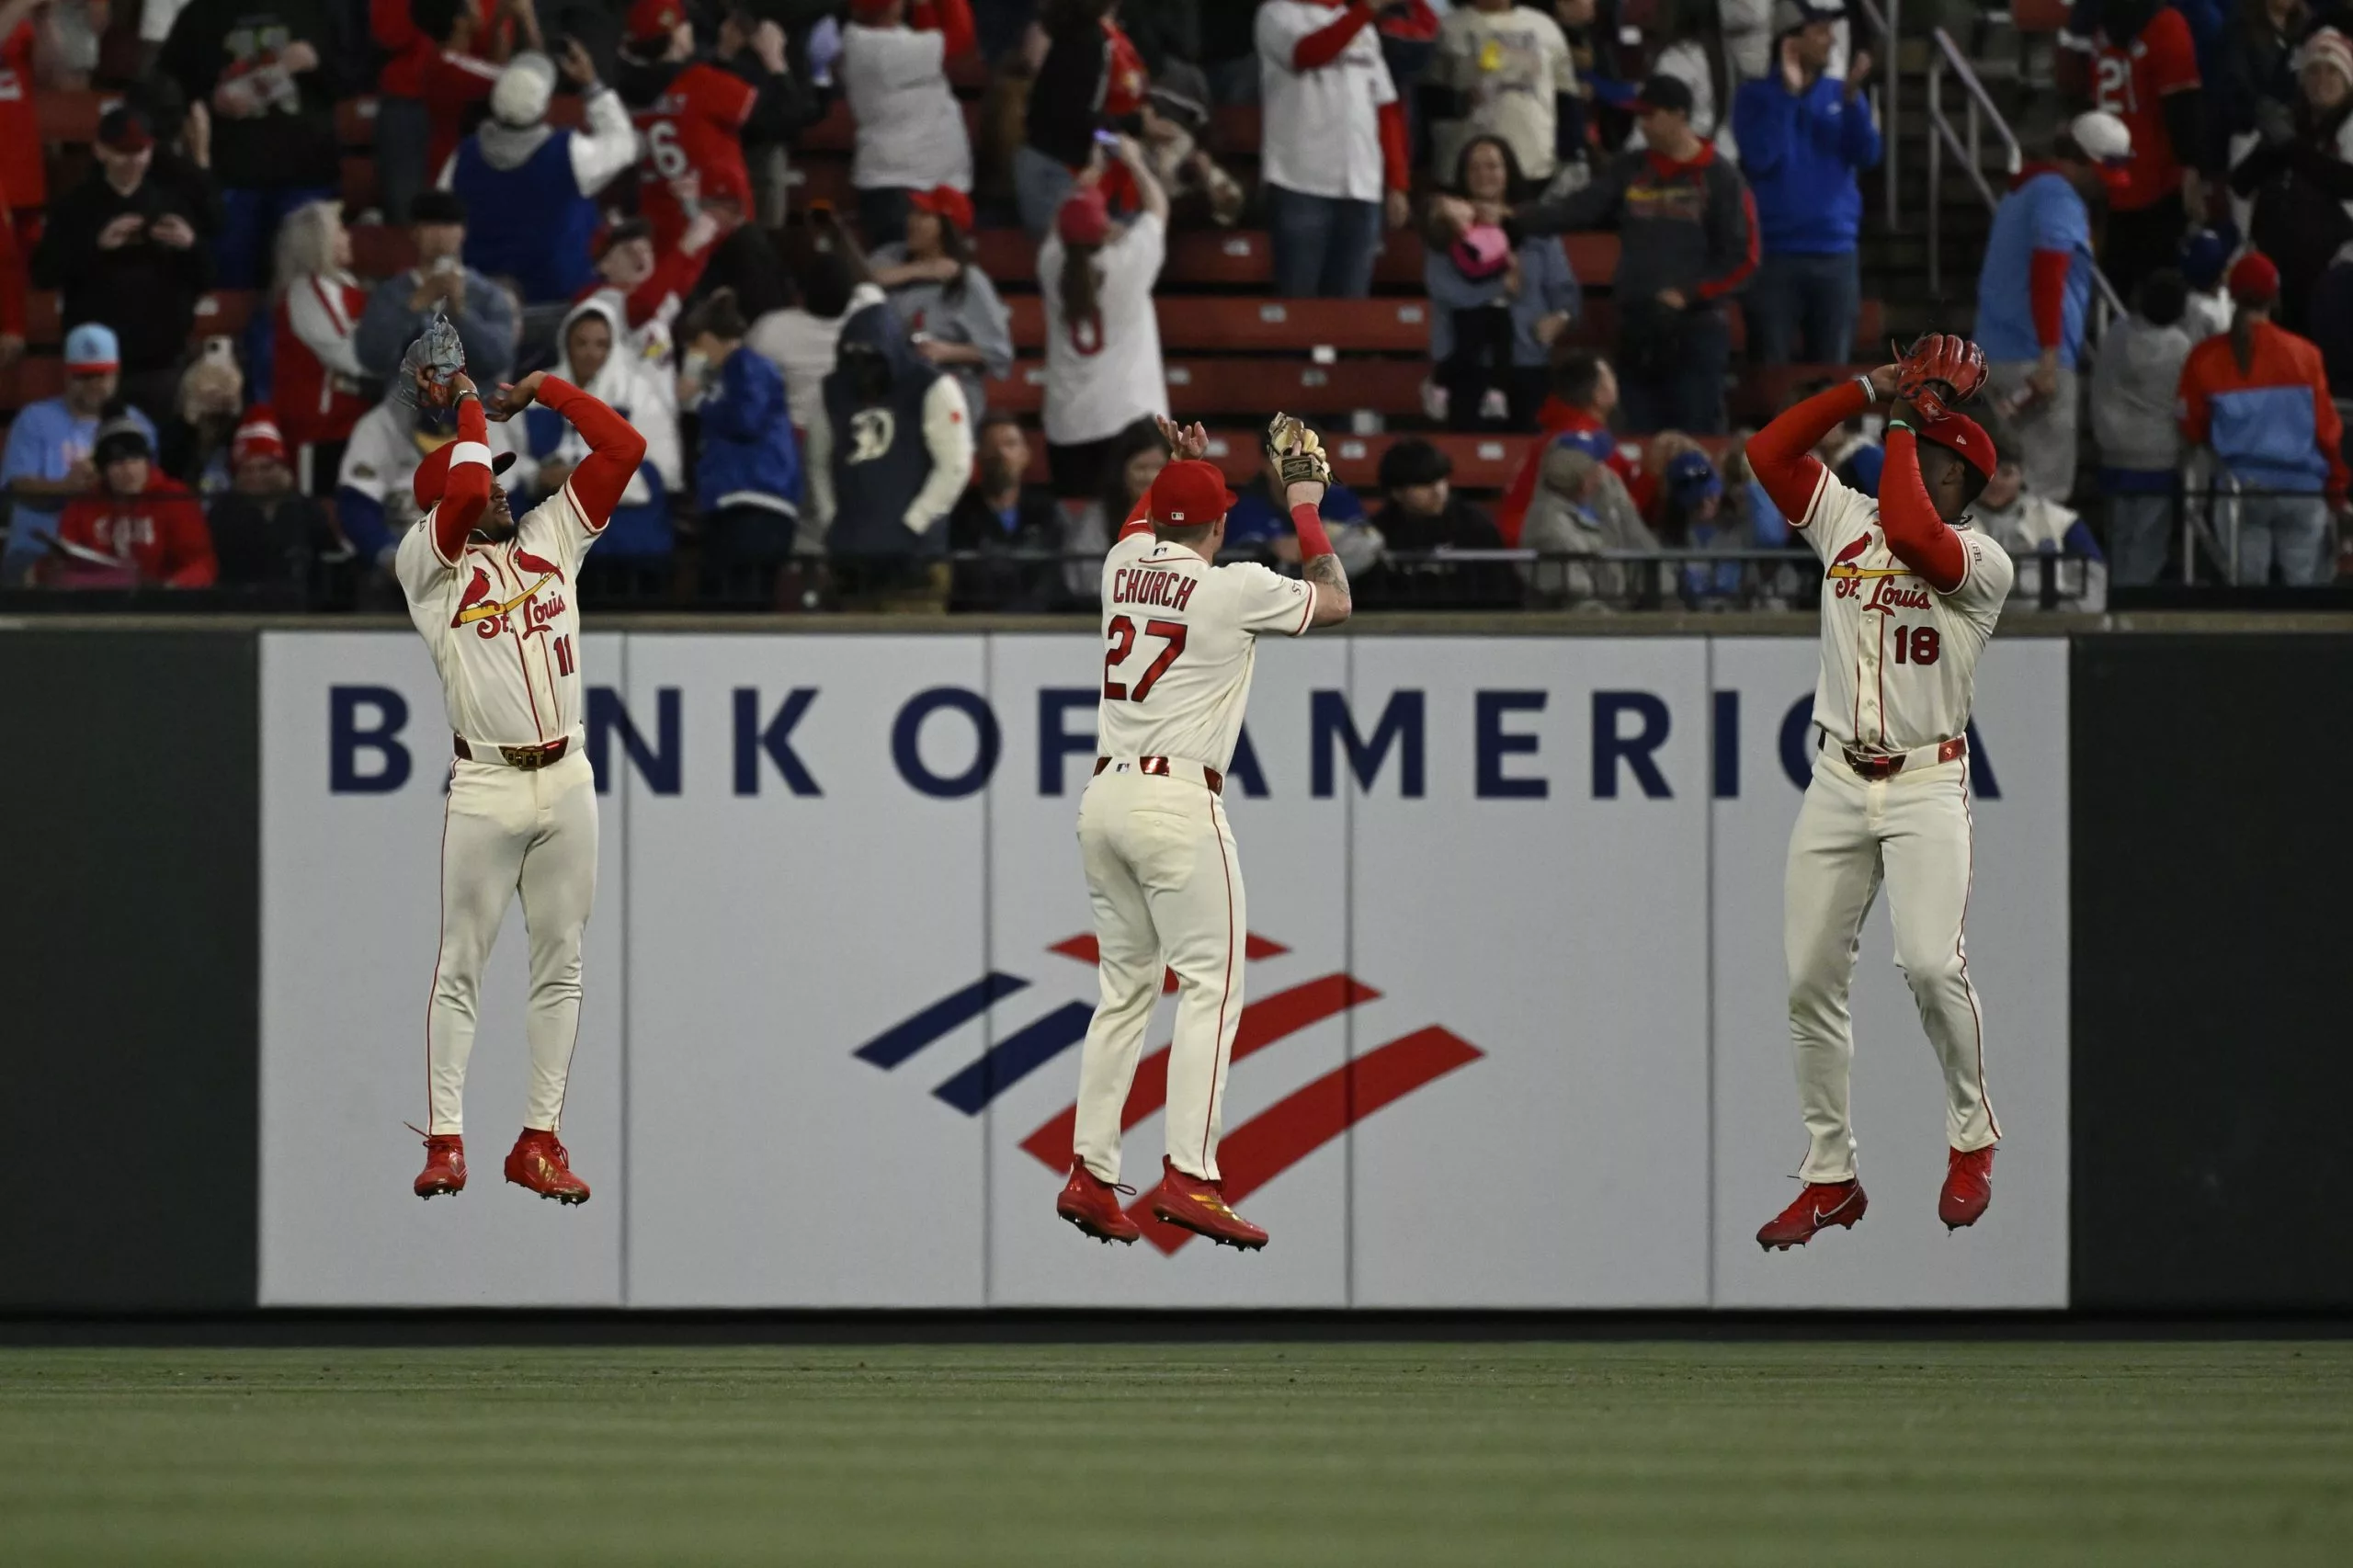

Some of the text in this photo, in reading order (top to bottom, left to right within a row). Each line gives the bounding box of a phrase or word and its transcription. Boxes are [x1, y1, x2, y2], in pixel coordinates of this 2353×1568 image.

[1112, 568, 1198, 612] CHURCH
[1862, 574, 1932, 618] Louis
[522, 591, 566, 641] Louis
[553, 633, 574, 677] 11
[1103, 614, 1188, 704] 27
[1893, 624, 1940, 665] 18
[329, 684, 824, 798] BNK
[890, 686, 1099, 801] OF
